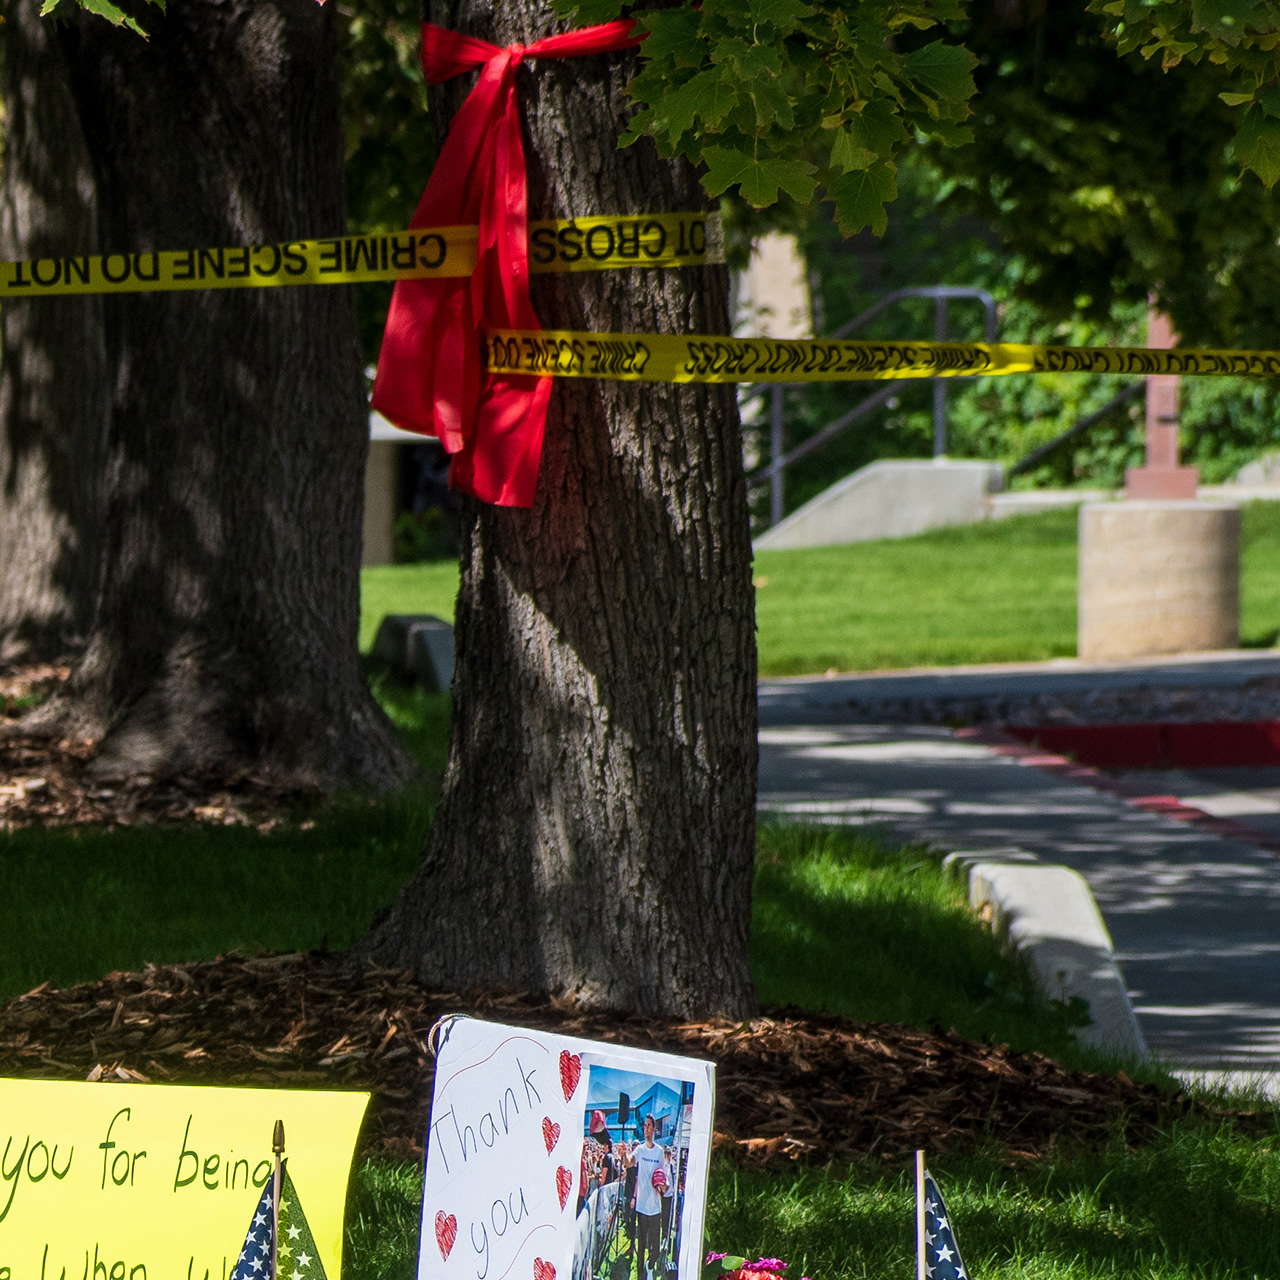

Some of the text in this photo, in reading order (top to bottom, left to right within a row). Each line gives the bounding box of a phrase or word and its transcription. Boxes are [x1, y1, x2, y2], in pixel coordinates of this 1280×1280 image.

[320, 233, 447, 273] CRIME
[531, 221, 666, 264] CROSS
[8, 257, 90, 289] NOT
[102, 253, 160, 283] DO
[173, 243, 308, 280] SCENE
[521, 339, 585, 374] SCENE
[588, 341, 651, 375] CRIME
[684, 341, 760, 376] CROSS
[756, 344, 807, 375] NOT
[430, 1057, 542, 1174] Thank
[98, 1107, 147, 1190] for
[471, 1187, 529, 1280] you
